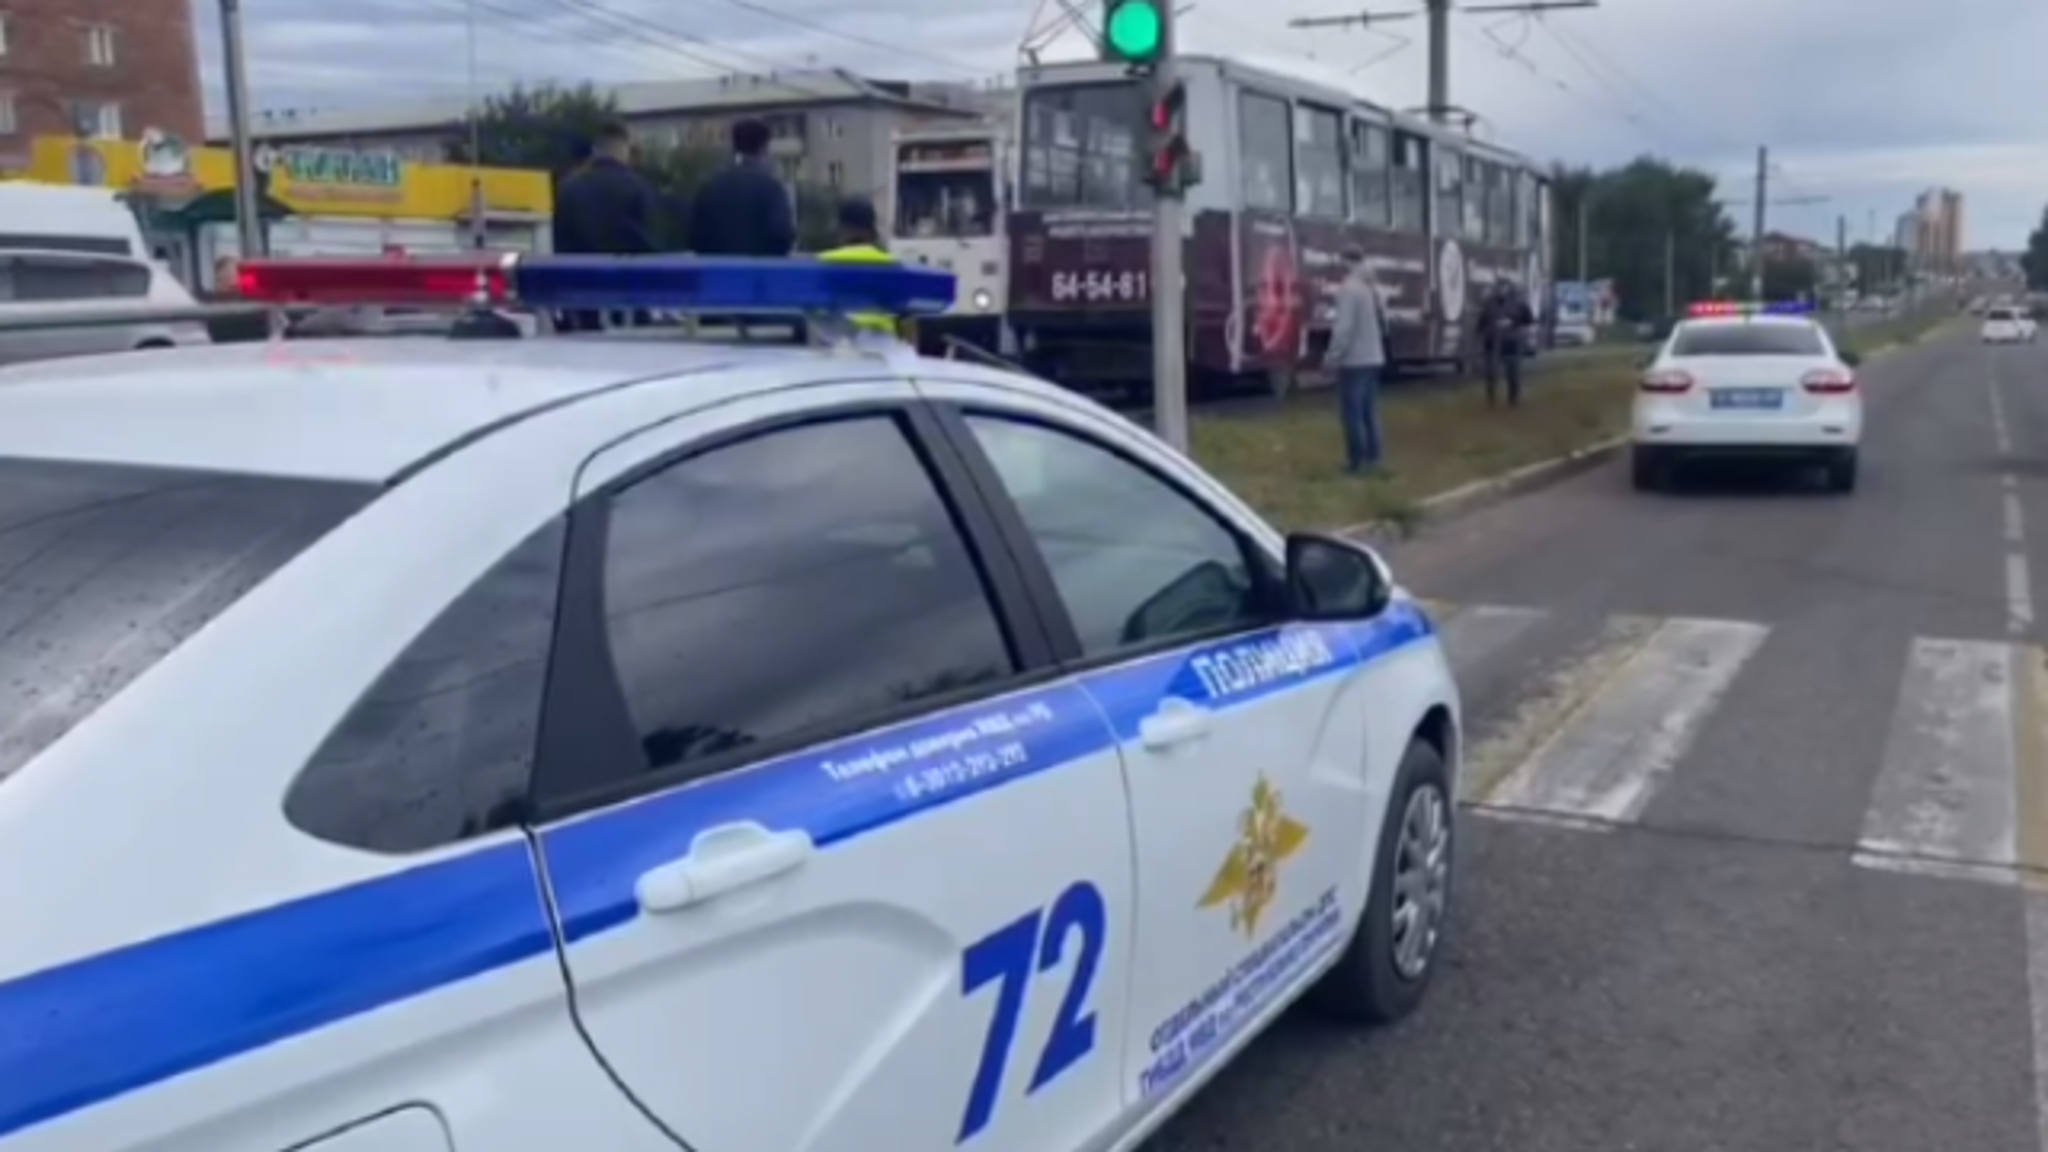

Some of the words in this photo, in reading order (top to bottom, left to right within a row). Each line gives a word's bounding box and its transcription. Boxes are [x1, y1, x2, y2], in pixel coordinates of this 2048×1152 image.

[1190, 629, 1334, 699] ПОЛИЦИЯ
[821, 749, 909, 781] Телефон
[953, 880, 1107, 1147] 72
